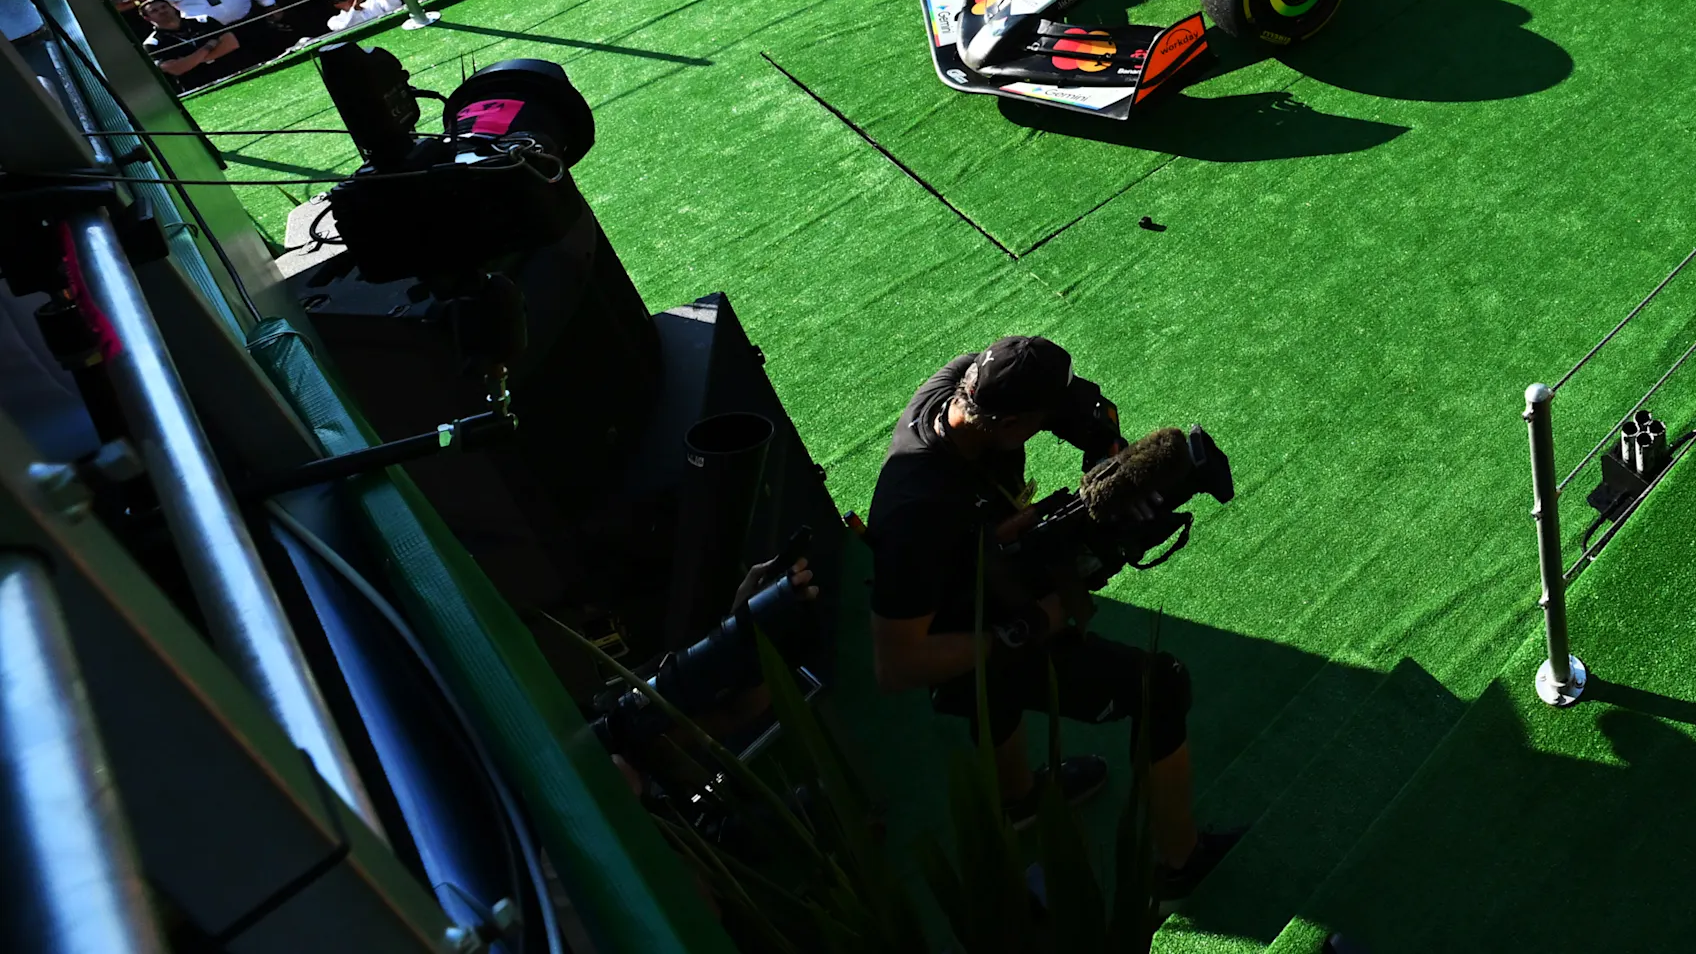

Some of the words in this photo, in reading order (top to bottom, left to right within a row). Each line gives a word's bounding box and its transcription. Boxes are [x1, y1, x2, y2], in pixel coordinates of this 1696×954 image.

[938, 10, 951, 34] Gemini
[1160, 30, 1199, 55] workday
[1045, 88, 1092, 102] Gemini
